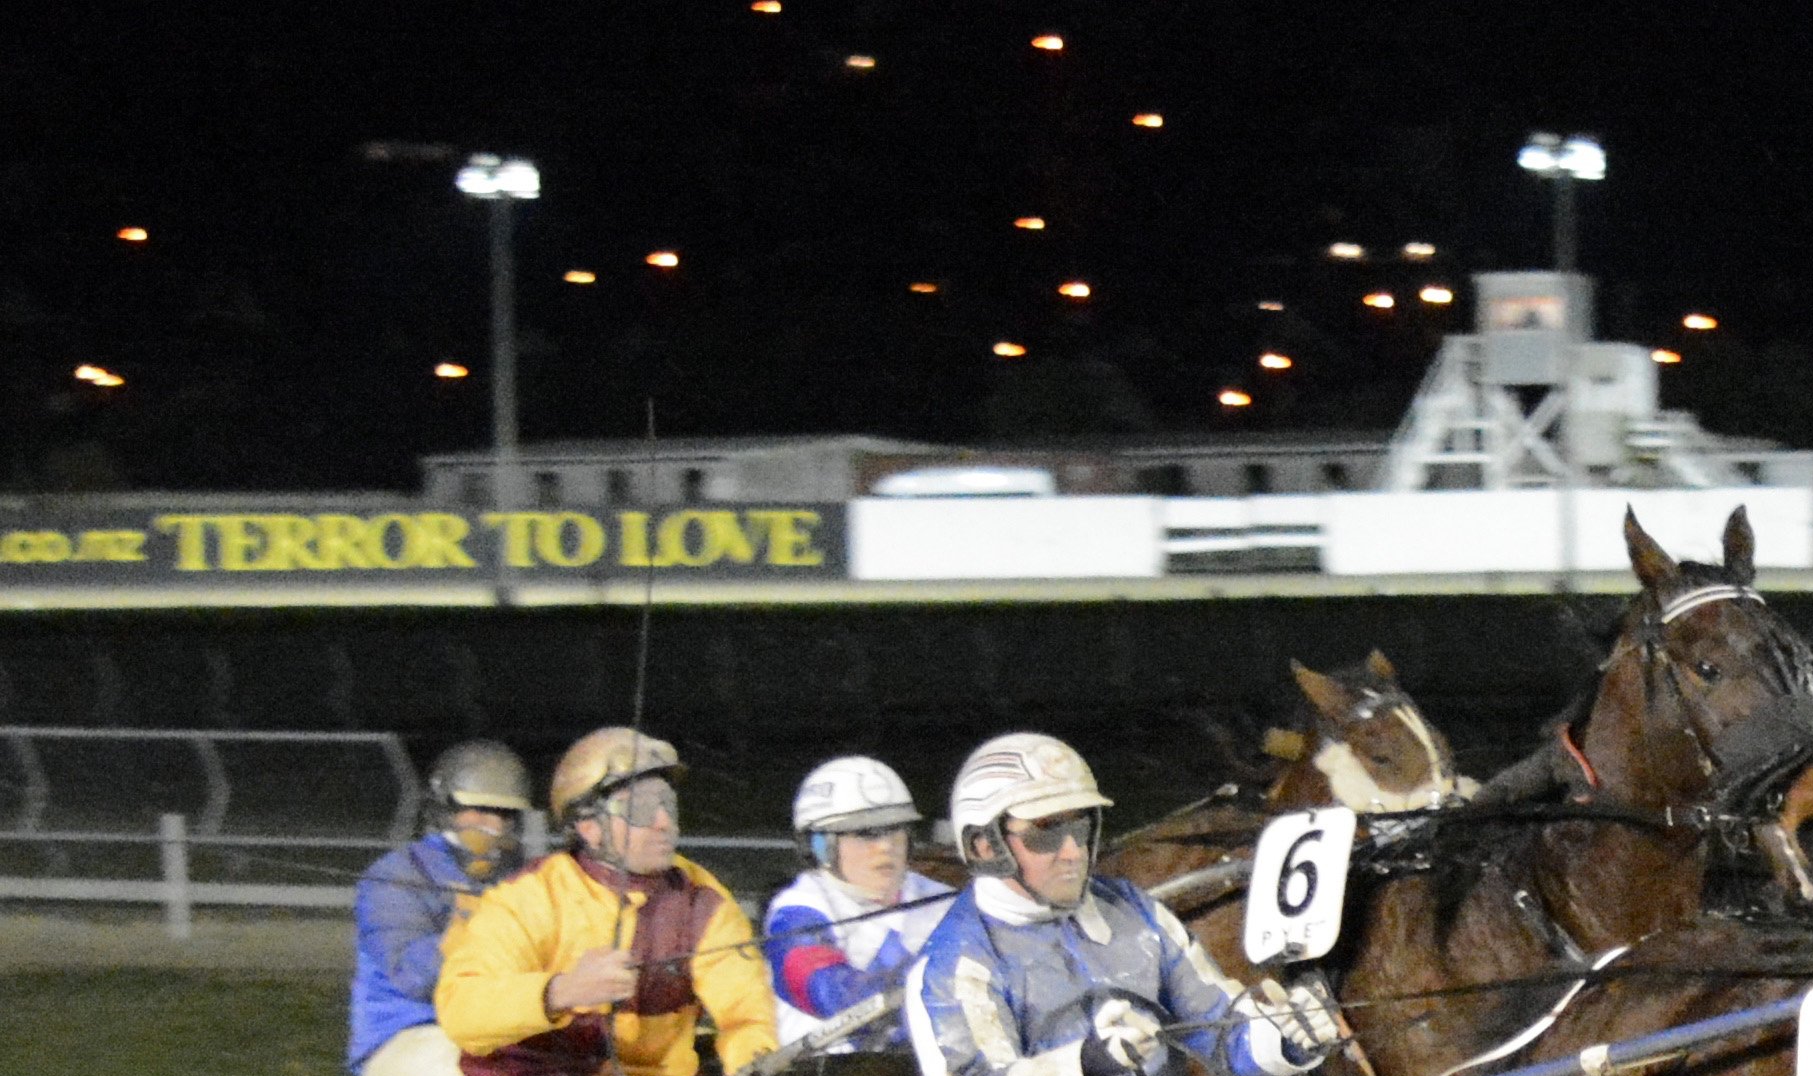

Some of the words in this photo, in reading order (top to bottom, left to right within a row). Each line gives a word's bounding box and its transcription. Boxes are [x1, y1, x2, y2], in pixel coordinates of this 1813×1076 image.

[154, 513, 478, 571] TERROR
[479, 511, 606, 567] TO
[618, 509, 824, 567] LOVE
[1277, 829, 1325, 918] 6
